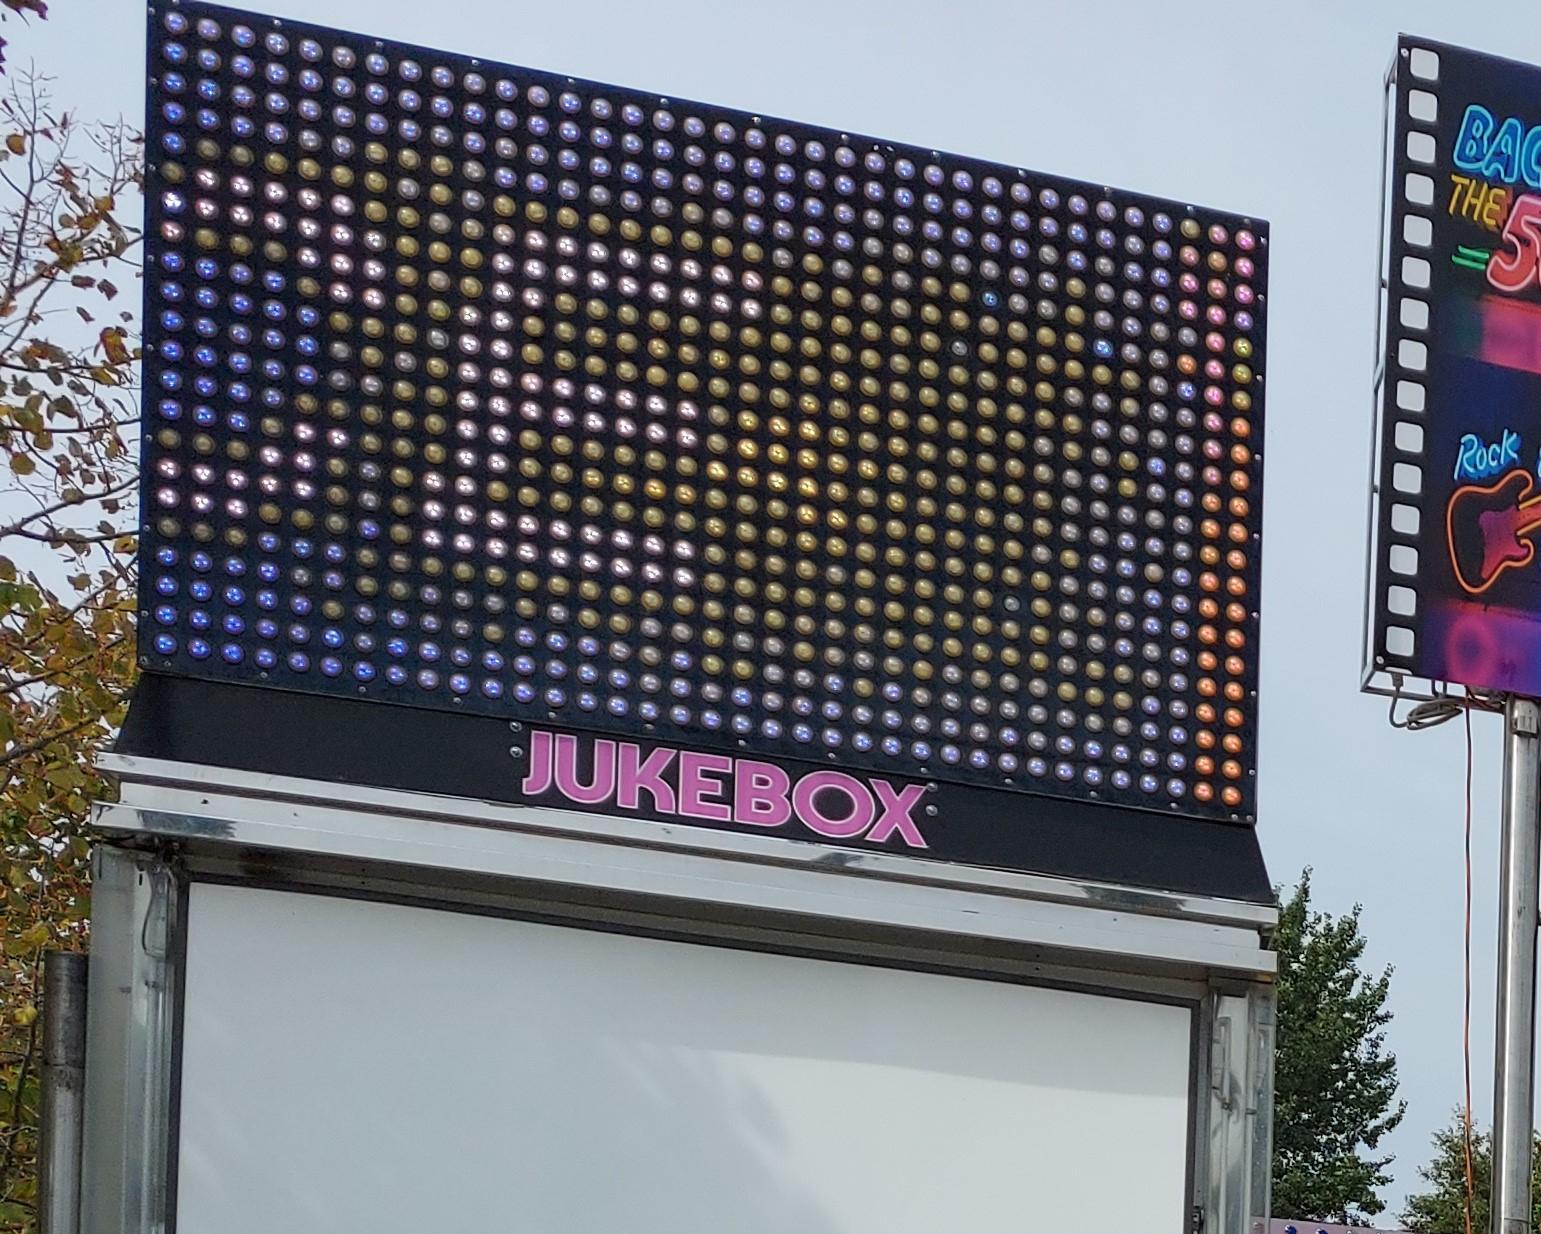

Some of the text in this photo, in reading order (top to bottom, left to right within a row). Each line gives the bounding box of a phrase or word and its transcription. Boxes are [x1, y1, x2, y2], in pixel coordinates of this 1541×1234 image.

[1449, 174, 1506, 226] THE
[1454, 428, 1519, 480] Rock
[521, 730, 938, 849] JUKEBOX
